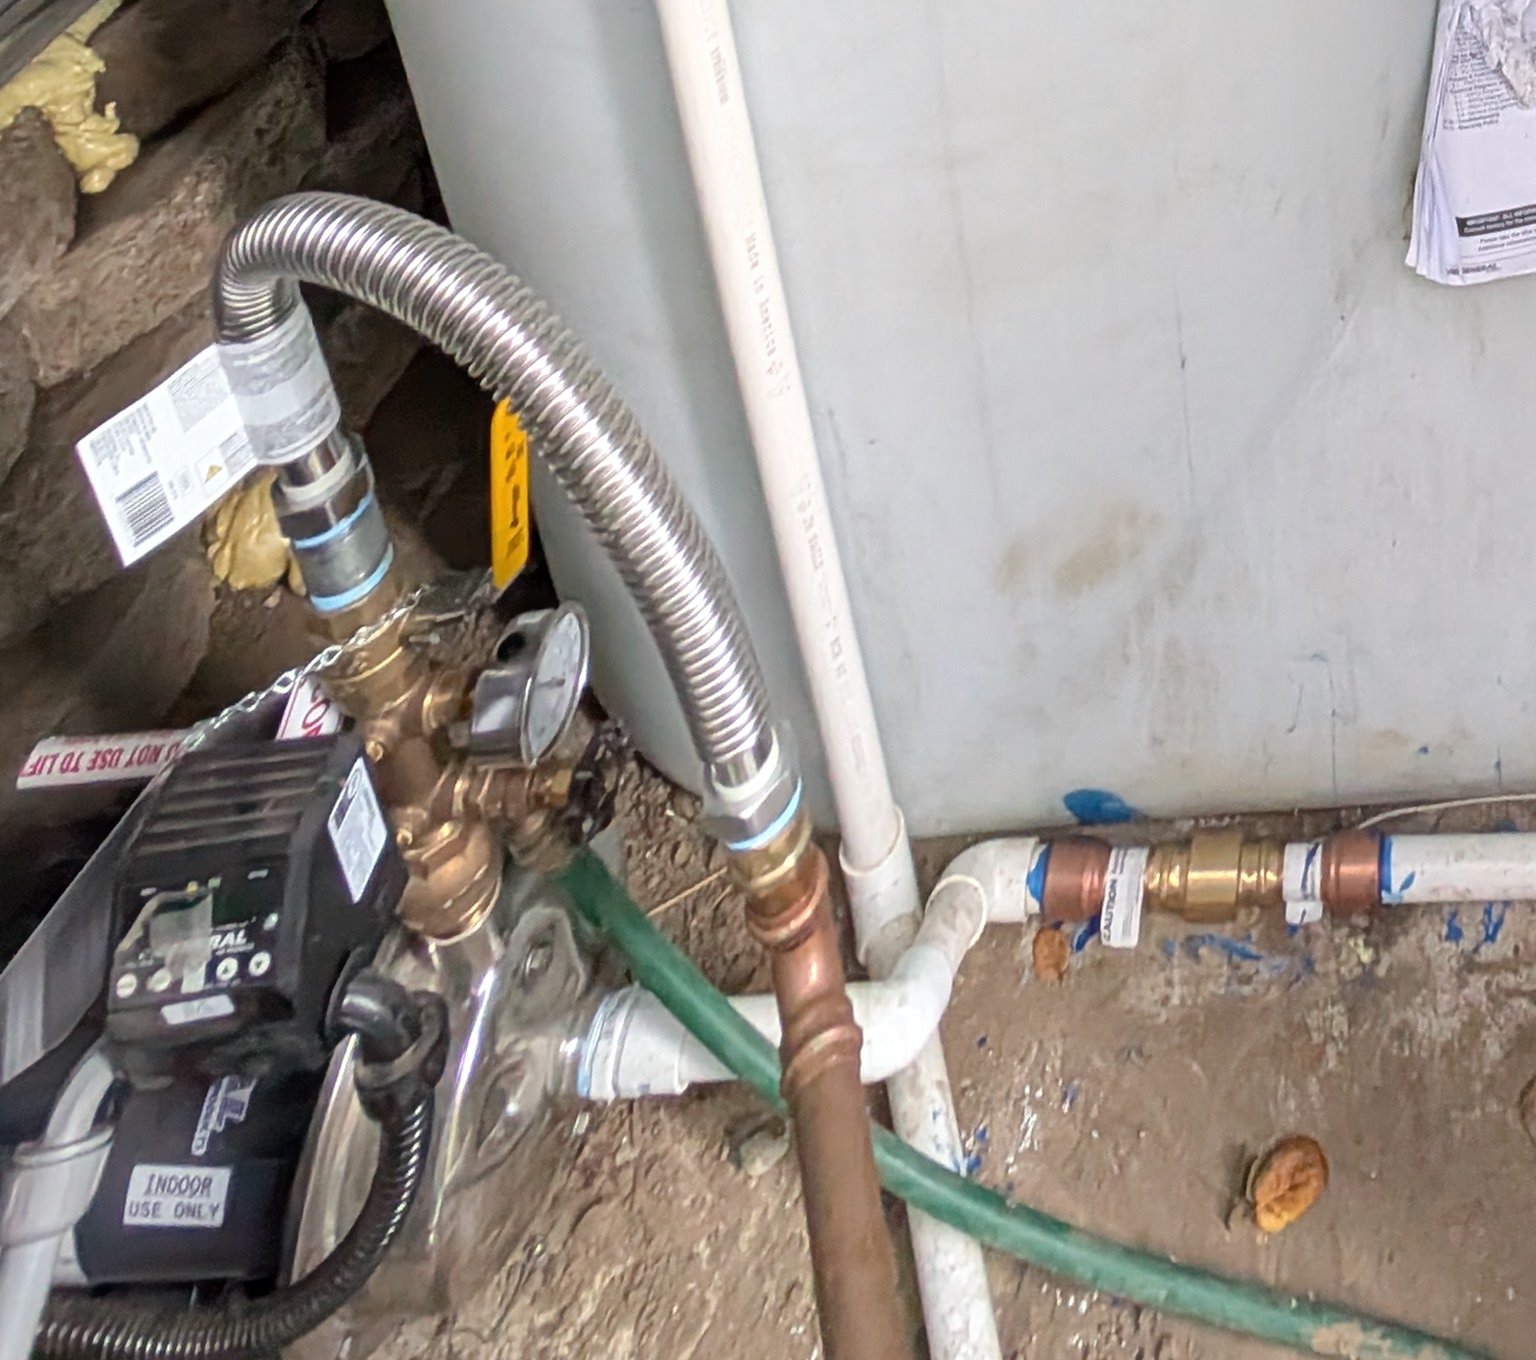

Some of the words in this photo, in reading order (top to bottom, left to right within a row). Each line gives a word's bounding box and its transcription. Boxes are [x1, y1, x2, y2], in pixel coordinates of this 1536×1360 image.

[60, 750, 84, 774] TO
[87, 746, 124, 771] USE
[125, 742, 165, 768] NOT
[1103, 879, 1118, 942] CAUTION
[143, 1173, 213, 1198] INDOOR
[128, 1201, 162, 1218] USE
[174, 1201, 219, 1219] ONLY
